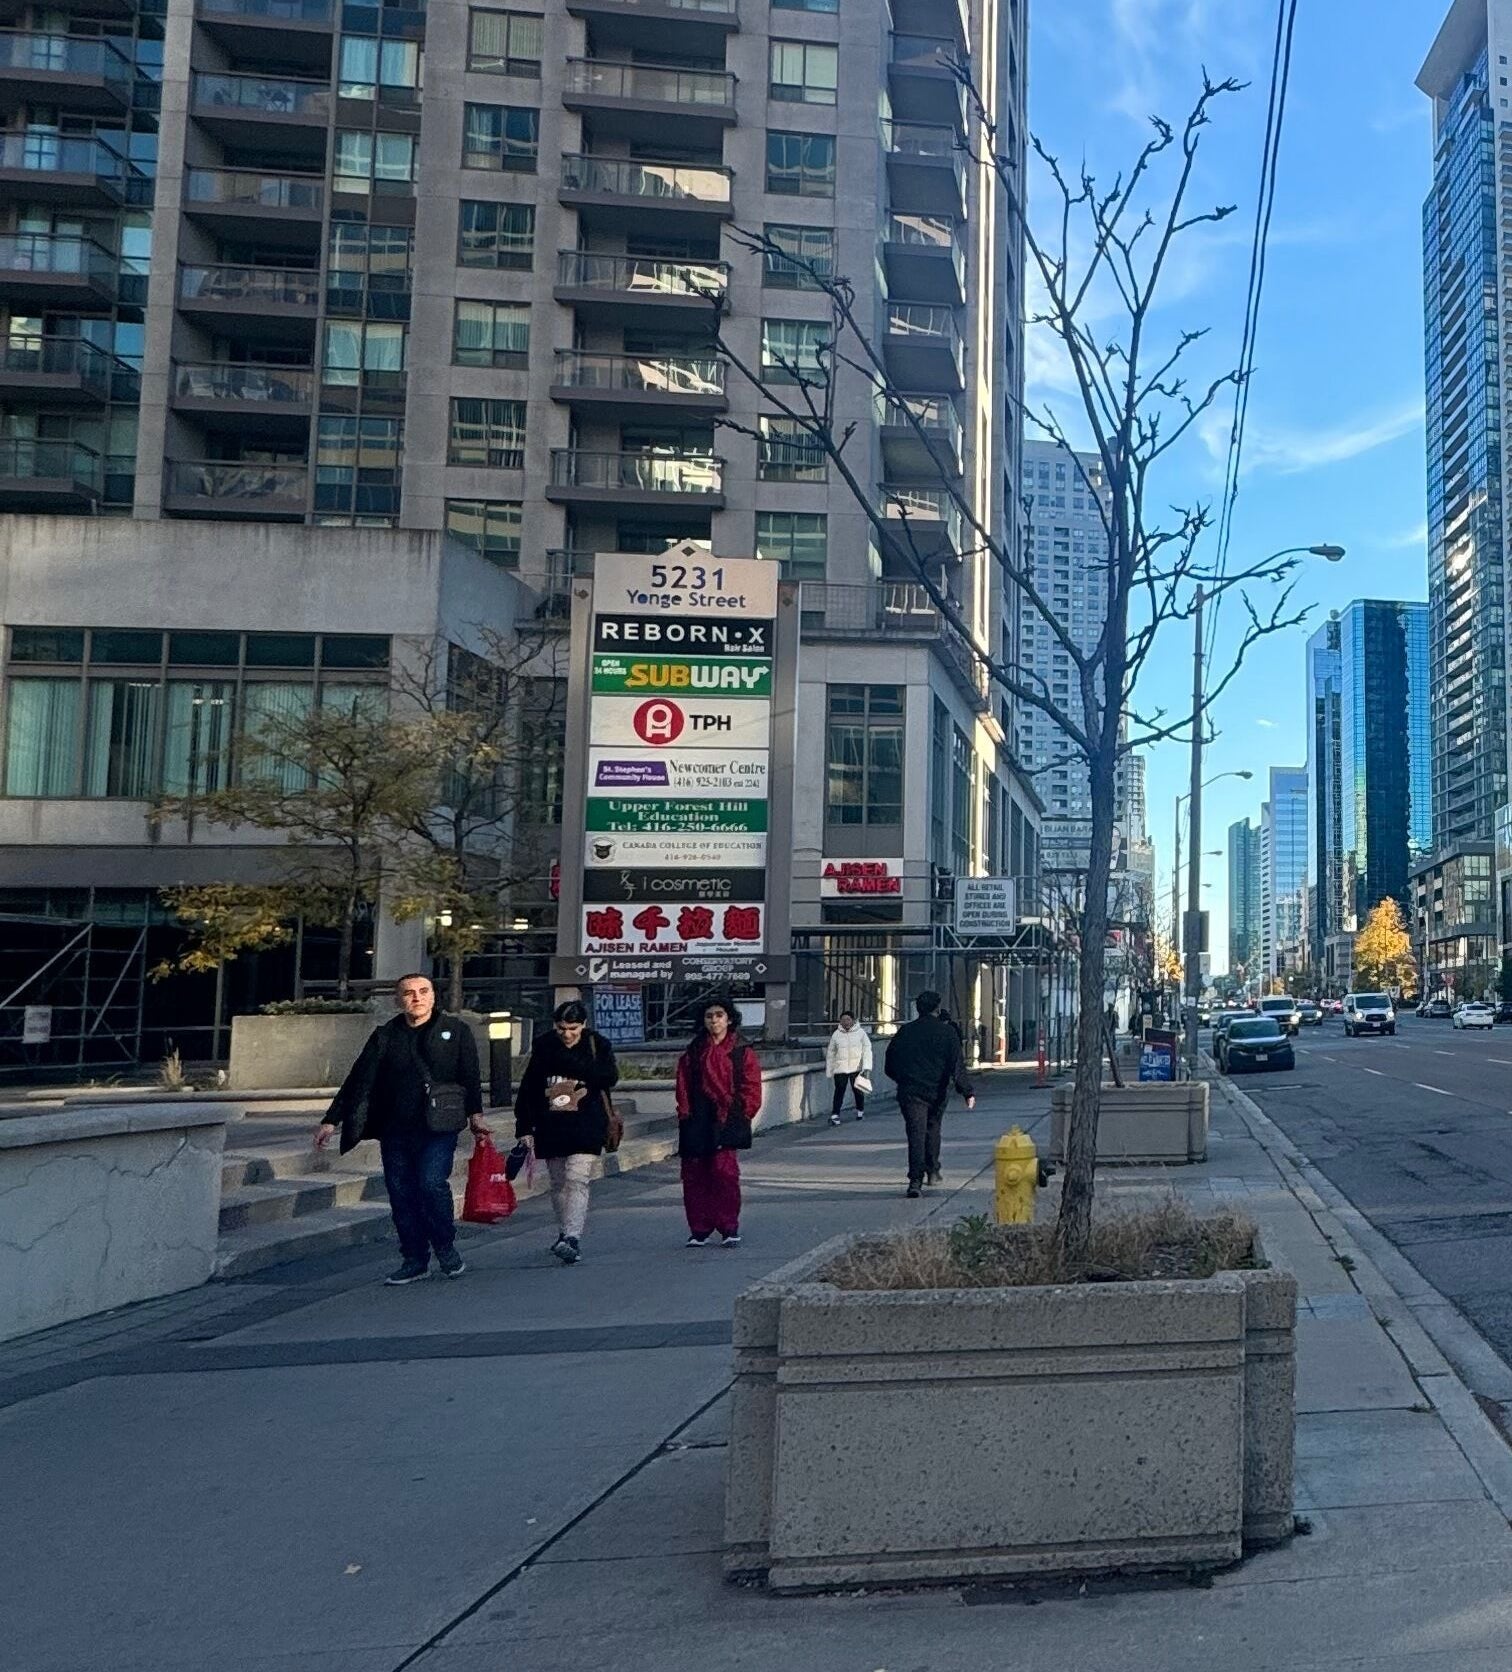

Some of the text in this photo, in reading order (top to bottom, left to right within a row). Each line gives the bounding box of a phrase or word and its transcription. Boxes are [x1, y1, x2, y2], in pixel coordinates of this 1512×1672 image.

[651, 565, 724, 590] 5231
[627, 589, 746, 608] Yonge Street
[624, 664, 769, 688] SUBWAY
[689, 715, 731, 730] TPH
[670, 759, 766, 774] Newcomer Centre
[608, 801, 748, 812] Upper Forest Hill
[638, 812, 719, 821] Education
[607, 822, 637, 831] Tel:
[823, 862, 887, 878] AJISEN
[651, 878, 732, 891] cosmetic
[837, 876, 901, 893] RAMEN
[585, 942, 688, 953] AJISEN RAMEN
[612, 960, 672, 969] Leased and
[610, 970, 673, 980] managed by
[594, 994, 641, 1010] FOR LEASE
